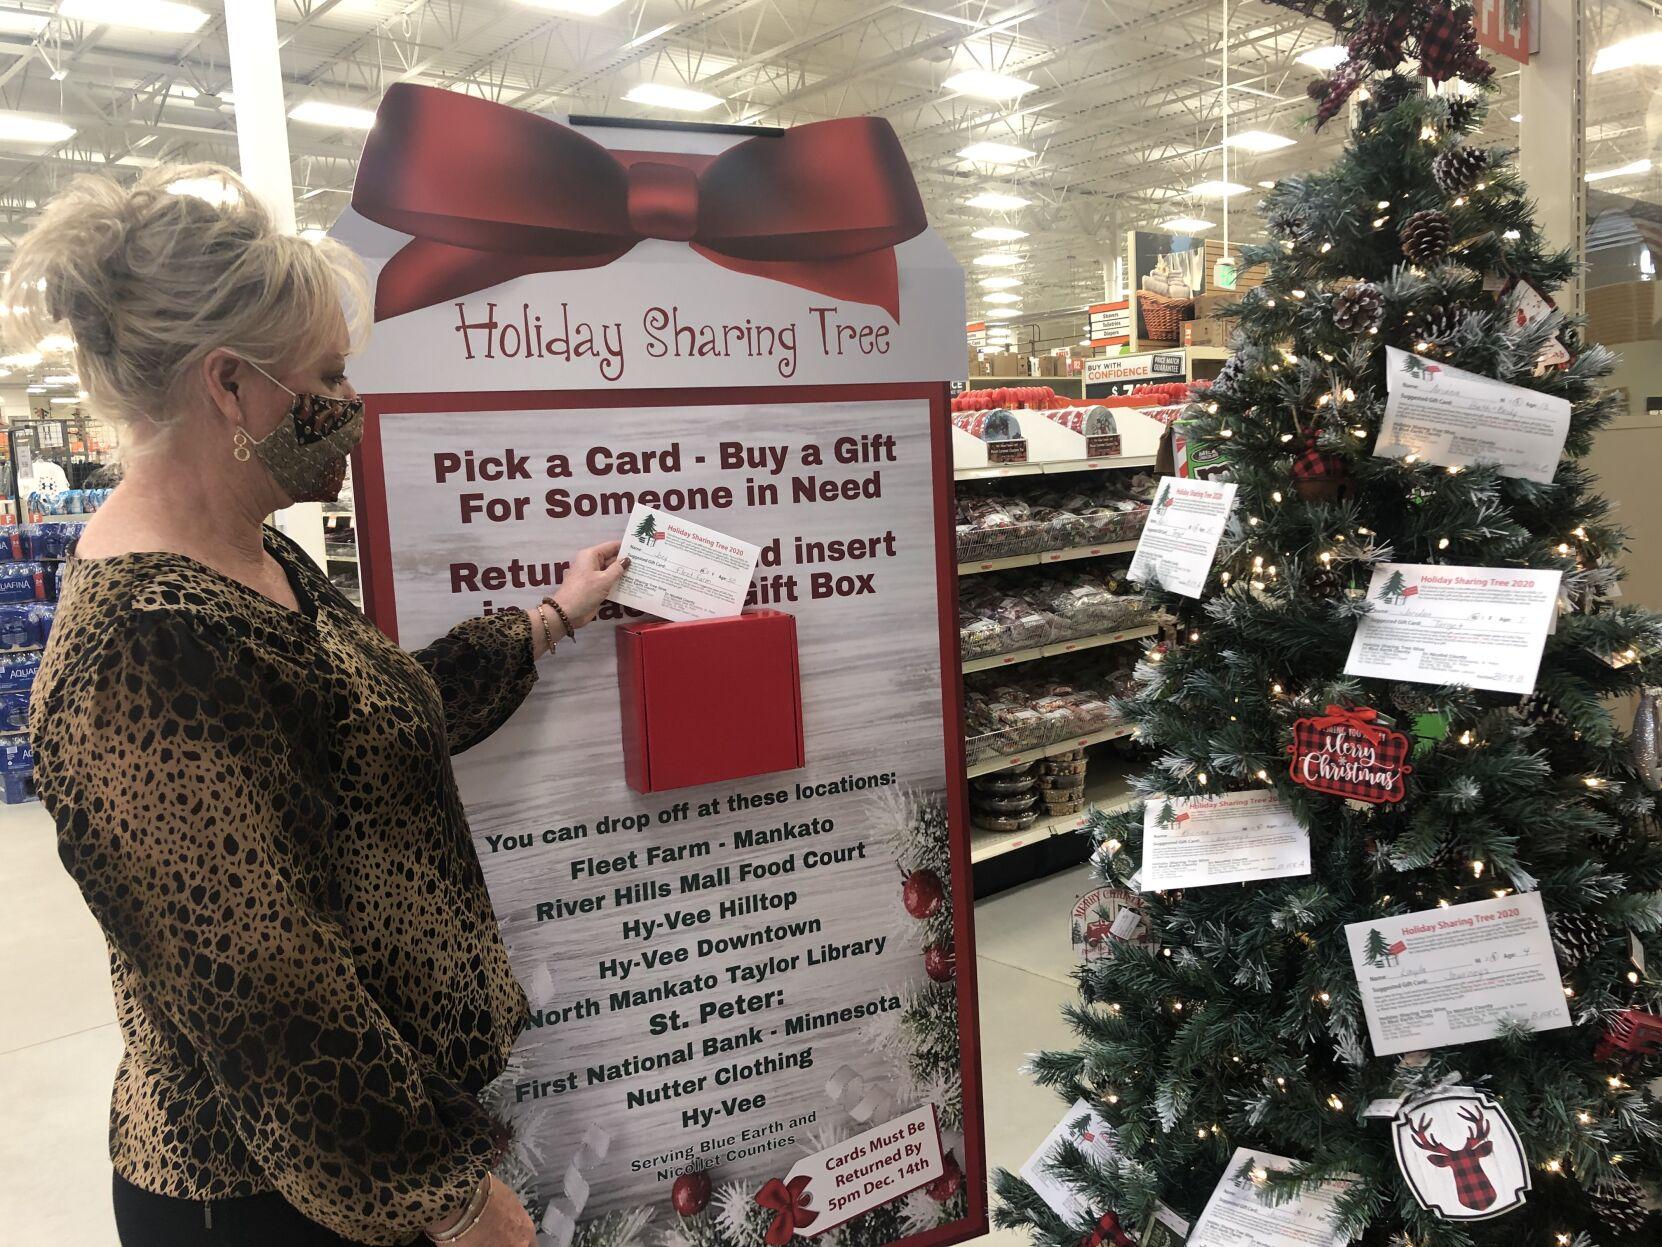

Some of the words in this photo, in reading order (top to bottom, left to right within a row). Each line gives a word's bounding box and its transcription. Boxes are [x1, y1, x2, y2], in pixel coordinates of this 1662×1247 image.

[455, 303, 624, 381] Holiday
[643, 306, 796, 378] Sharing
[809, 307, 889, 355] Tree
[1089, 367, 1148, 380] CONFIDENCE
[434, 449, 532, 483] Pick
[547, 455, 572, 478] a
[586, 443, 681, 476] Card
[720, 442, 788, 475] Buy
[801, 444, 823, 466] a
[834, 434, 896, 464] Gift
[460, 493, 530, 523] For
[545, 482, 733, 518] Someone
[746, 478, 784, 506] in
[792, 471, 881, 503] Need
[668, 524, 691, 539] Holiday
[692, 533, 715, 547] Sharing
[716, 541, 729, 551] Tree
[729, 546, 744, 556] 2020
[795, 531, 896, 564] insert
[450, 559, 570, 593] Retur
[811, 572, 876, 599] Box
[1421, 575, 1452, 585] Holiday
[1454, 577, 1488, 587] Sharing
[1490, 578, 1510, 587] Tree
[1511, 579, 1534, 588] 2020
[1299, 752, 1401, 790] Christmas
[1320, 734, 1395, 768] Merry
[485, 833, 533, 853] You
[542, 824, 587, 843] can
[596, 814, 650, 834] drop
[658, 802, 689, 823] off
[698, 799, 720, 817] at
[727, 791, 788, 811] these
[796, 772, 896, 800] locations:
[1189, 801, 1218, 810] Holiday
[1219, 799, 1249, 807] Sharing
[571, 851, 638, 880] Fleet
[647, 842, 710, 866] Farm
[734, 818, 833, 849] Mankato
[536, 895, 605, 922] River
[615, 881, 671, 906] Hills
[680, 866, 730, 894] Mall
[739, 854, 795, 882] Food
[803, 842, 866, 868] Court
[1074, 890, 1101, 919] MERRY
[623, 909, 711, 941] Hy-Vee
[720, 891, 797, 919] Hilltop
[1402, 924, 1437, 937] Holiday
[1437, 917, 1474, 931] Sharing
[1476, 913, 1495, 924] Tree
[1497, 908, 1520, 920] 2020
[599, 948, 688, 980] Hy-Vee
[698, 919, 821, 957] Downtown
[527, 998, 600, 1031] North
[610, 974, 718, 1011] Mankato
[725, 955, 800, 984] Taylor
[807, 936, 886, 966] Library
[650, 1010, 689, 1035] St.
[700, 990, 784, 1024] Peter:
[516, 1072, 578, 1103] First
[587, 1042, 693, 1085] National
[703, 1027, 763, 1057] Bank
[785, 996, 901, 1036] Minnesota
[627, 1076, 707, 1109] Nutter
[715, 1047, 813, 1085] Clothing
[682, 1095, 766, 1128] Hy-Vee
[632, 1146, 694, 1172] Serving
[701, 1132, 735, 1157] Blue
[742, 1121, 783, 1148] Earth
[789, 1111, 816, 1134] and
[658, 1155, 720, 1182] Nicollet
[727, 1129, 795, 1161] Counties
[826, 1147, 866, 1170] Cards
[870, 1129, 905, 1152] Must
[908, 1122, 925, 1136] Be
[836, 1156, 902, 1189] Returned
[905, 1142, 921, 1164] By
[829, 1190, 860, 1211] 5pm
[864, 1170, 894, 1195] Dec.
[898, 1158, 929, 1182] 14th
